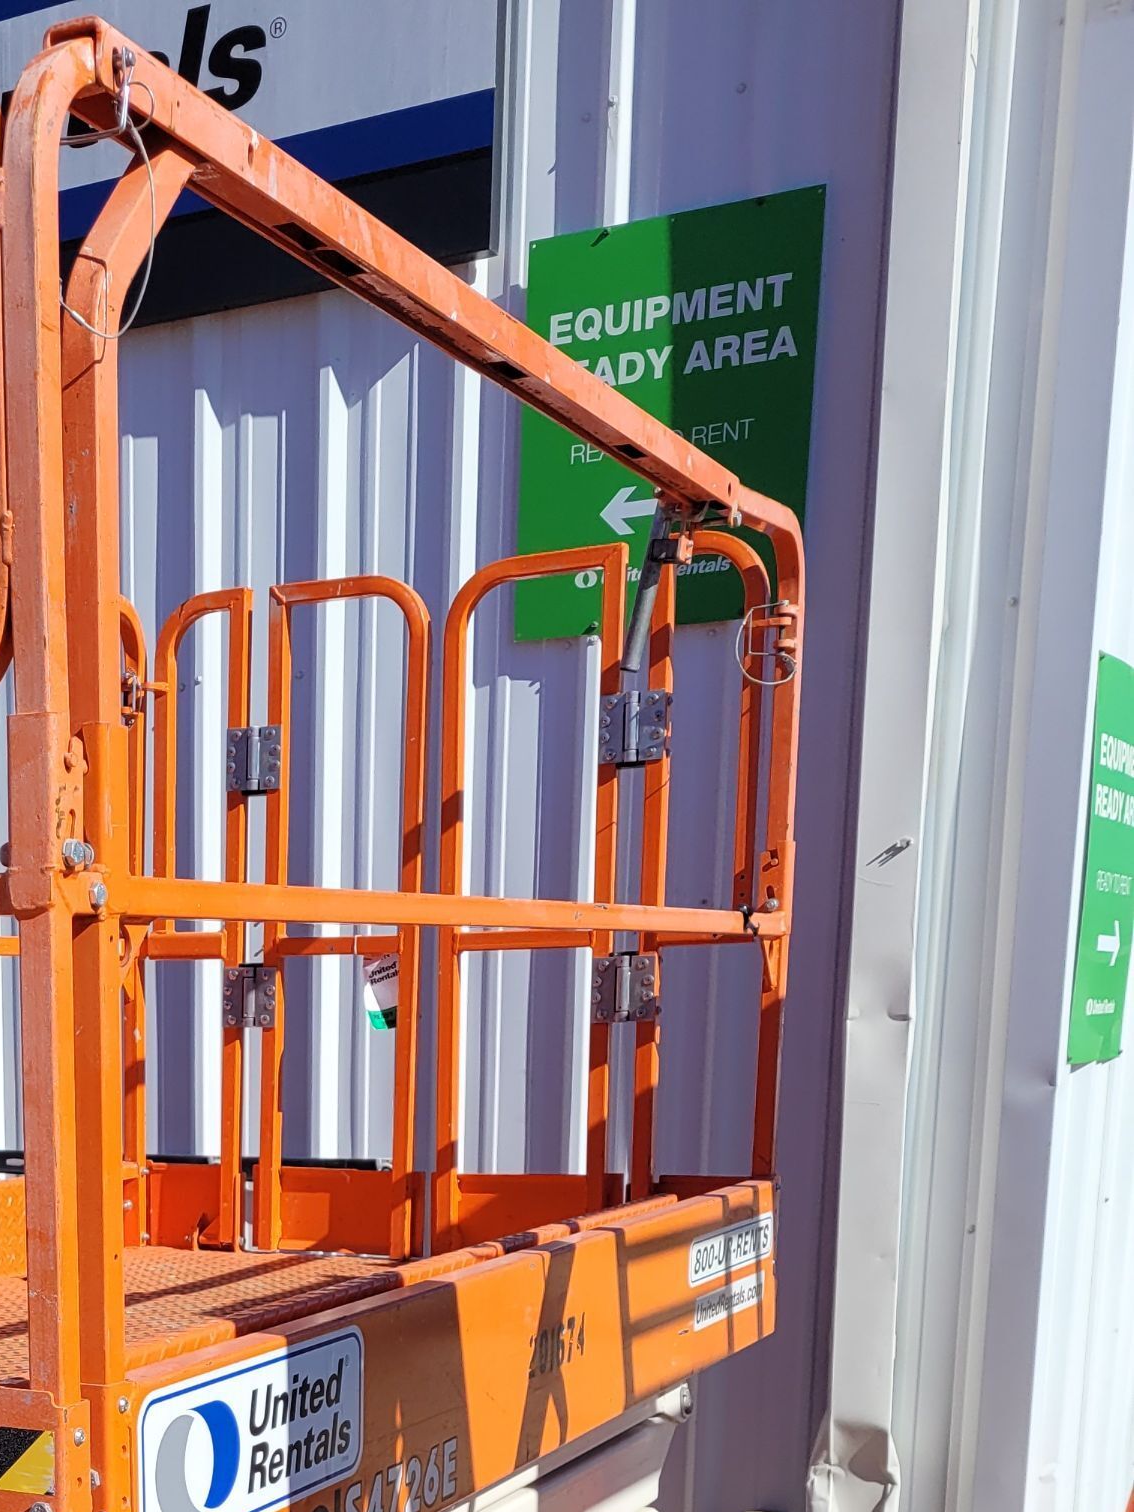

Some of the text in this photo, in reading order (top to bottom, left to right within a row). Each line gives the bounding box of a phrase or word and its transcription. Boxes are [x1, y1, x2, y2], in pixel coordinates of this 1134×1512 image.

[549, 272, 793, 346] EQUIPMENT
[575, 325, 798, 387] ADY AREA
[691, 418, 755, 446] RENT
[675, 556, 733, 577] entals
[1095, 783, 1125, 822] READY
[694, 1224, 769, 1275] 800-UR-RENTS
[696, 1283, 763, 1324] UnitedRentals.com
[529, 1312, 585, 1380] 201674
[249, 1357, 344, 1437] United
[248, 1411, 351, 1494] Rentals
